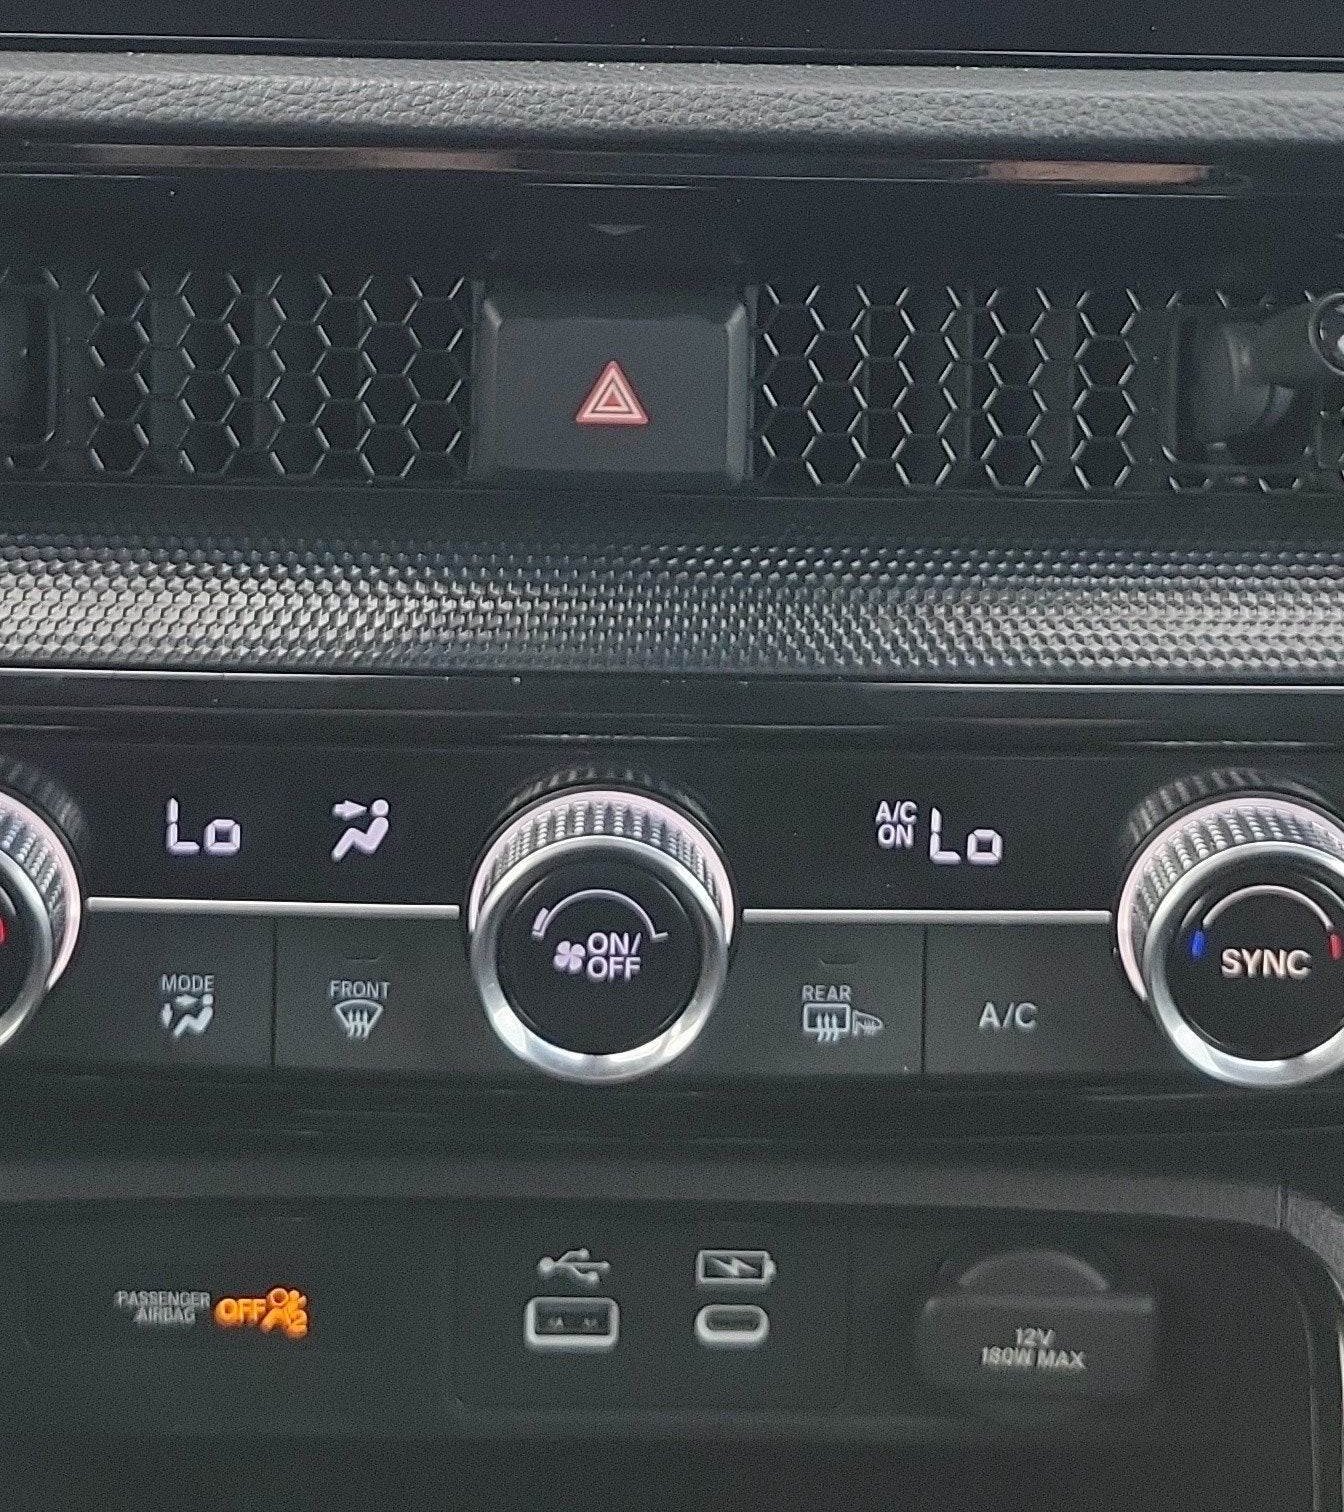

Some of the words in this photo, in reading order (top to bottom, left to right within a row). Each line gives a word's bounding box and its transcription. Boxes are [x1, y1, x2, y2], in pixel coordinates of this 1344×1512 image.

[875, 800, 918, 825] A/C
[166, 798, 241, 855] Lo
[877, 824, 915, 849] ON
[929, 807, 1004, 865] Lo
[587, 931, 642, 956] ON/
[587, 956, 642, 982] OFF
[1221, 948, 1312, 980] SYNC
[160, 974, 216, 995] MODE
[329, 980, 390, 1001] FRONT
[802, 986, 852, 1002] REAR
[979, 1001, 1037, 1032] A/C
[116, 1290, 211, 1308] PASSENGER
[133, 1306, 197, 1325] AIRBAG
[215, 1298, 266, 1328] OFF
[1016, 1327, 1056, 1347] 12V
[981, 1346, 1035, 1367] 180W
[1037, 1349, 1086, 1369] MAX
